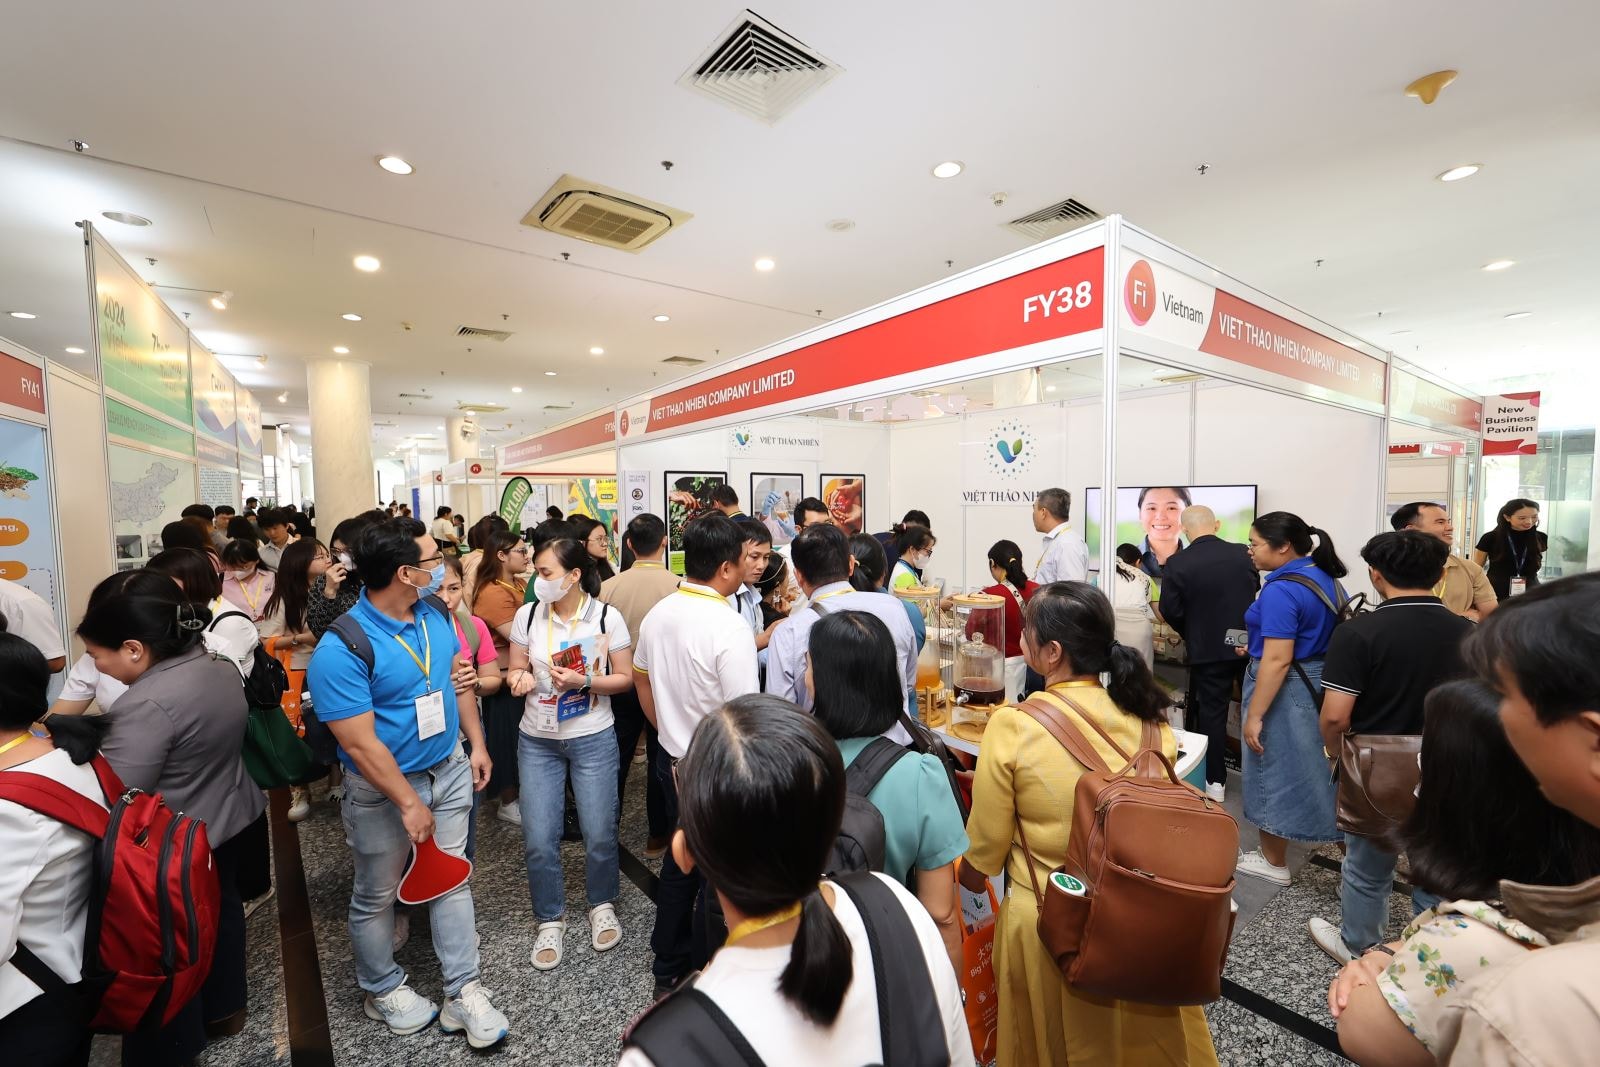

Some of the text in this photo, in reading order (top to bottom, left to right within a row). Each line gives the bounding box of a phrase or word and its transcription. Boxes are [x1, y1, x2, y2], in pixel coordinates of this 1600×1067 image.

[1023, 280, 1092, 323] FY38
[1133, 279, 1147, 308] Fi
[1162, 291, 1204, 325] Vietnam
[104, 295, 126, 331] 2024
[1218, 311, 1360, 382] VIET THAO NHIEN COMPANY LIMITED
[20, 377, 41, 399] FY41
[652, 368, 795, 421] VIET THAO NHIEN COMPANY LIMITED
[1485, 416, 1537, 425] Business
[1497, 406, 1525, 414] New
[1486, 425, 1533, 434] Pavilion
[962, 489, 987, 503] VIỆT
[988, 488, 1020, 502] THẢO
